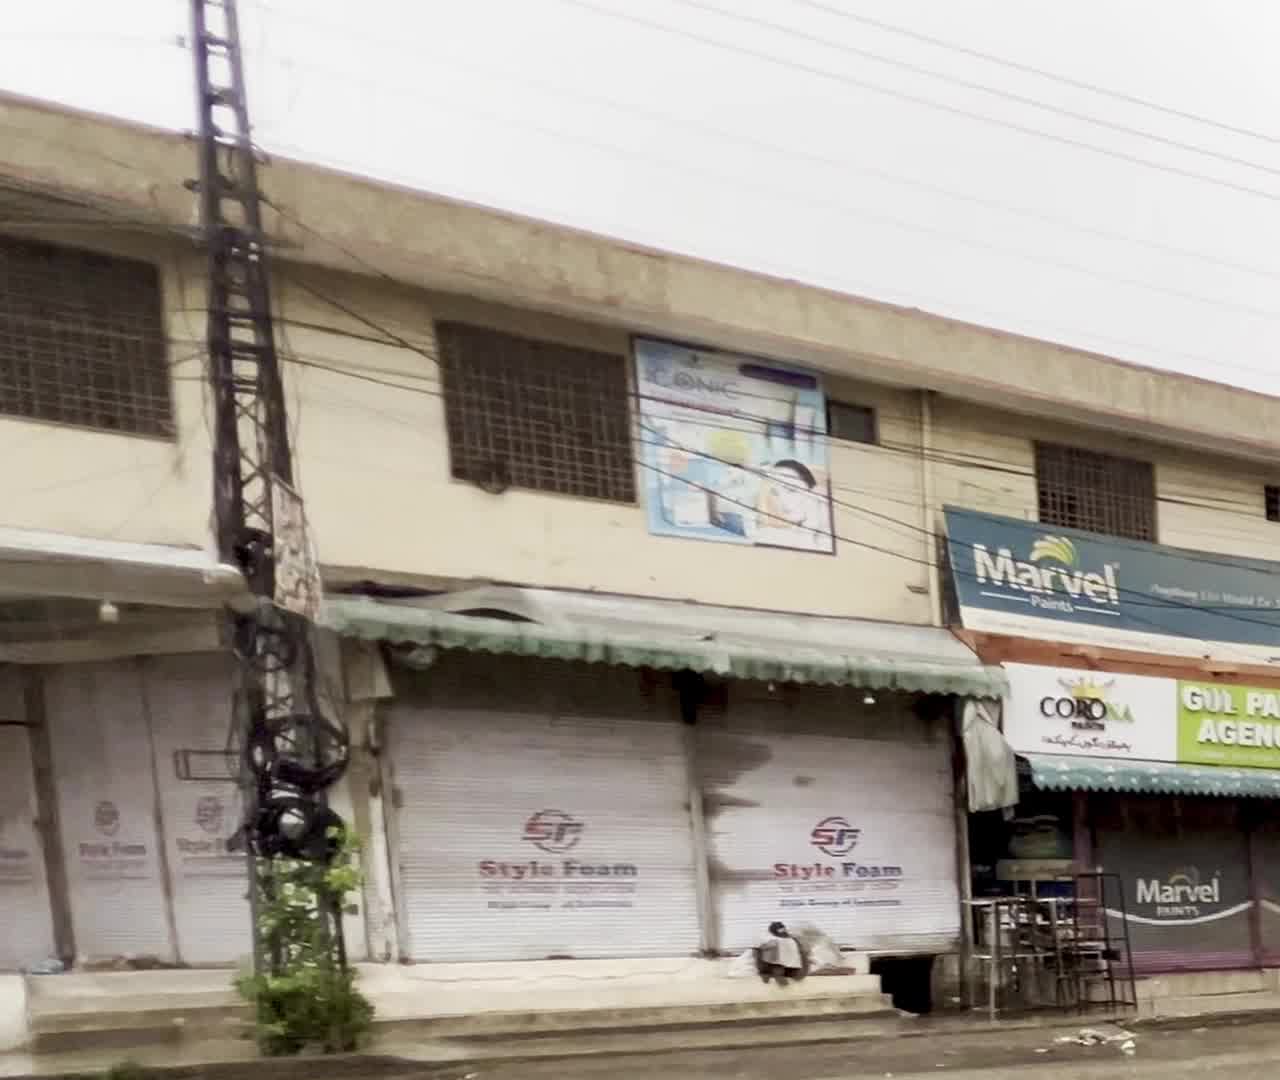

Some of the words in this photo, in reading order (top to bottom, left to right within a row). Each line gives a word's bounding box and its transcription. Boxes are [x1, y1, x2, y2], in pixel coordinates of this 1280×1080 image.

[973, 544, 1120, 605] Marvel
[1040, 695, 1135, 724] CORONA
[1183, 686, 1238, 715] GUL
[479, 860, 553, 880] Style
[563, 859, 638, 877] Foam
[774, 862, 835, 881] Style
[842, 862, 903, 878] Foam
[1136, 878, 1220, 903] Marvel
